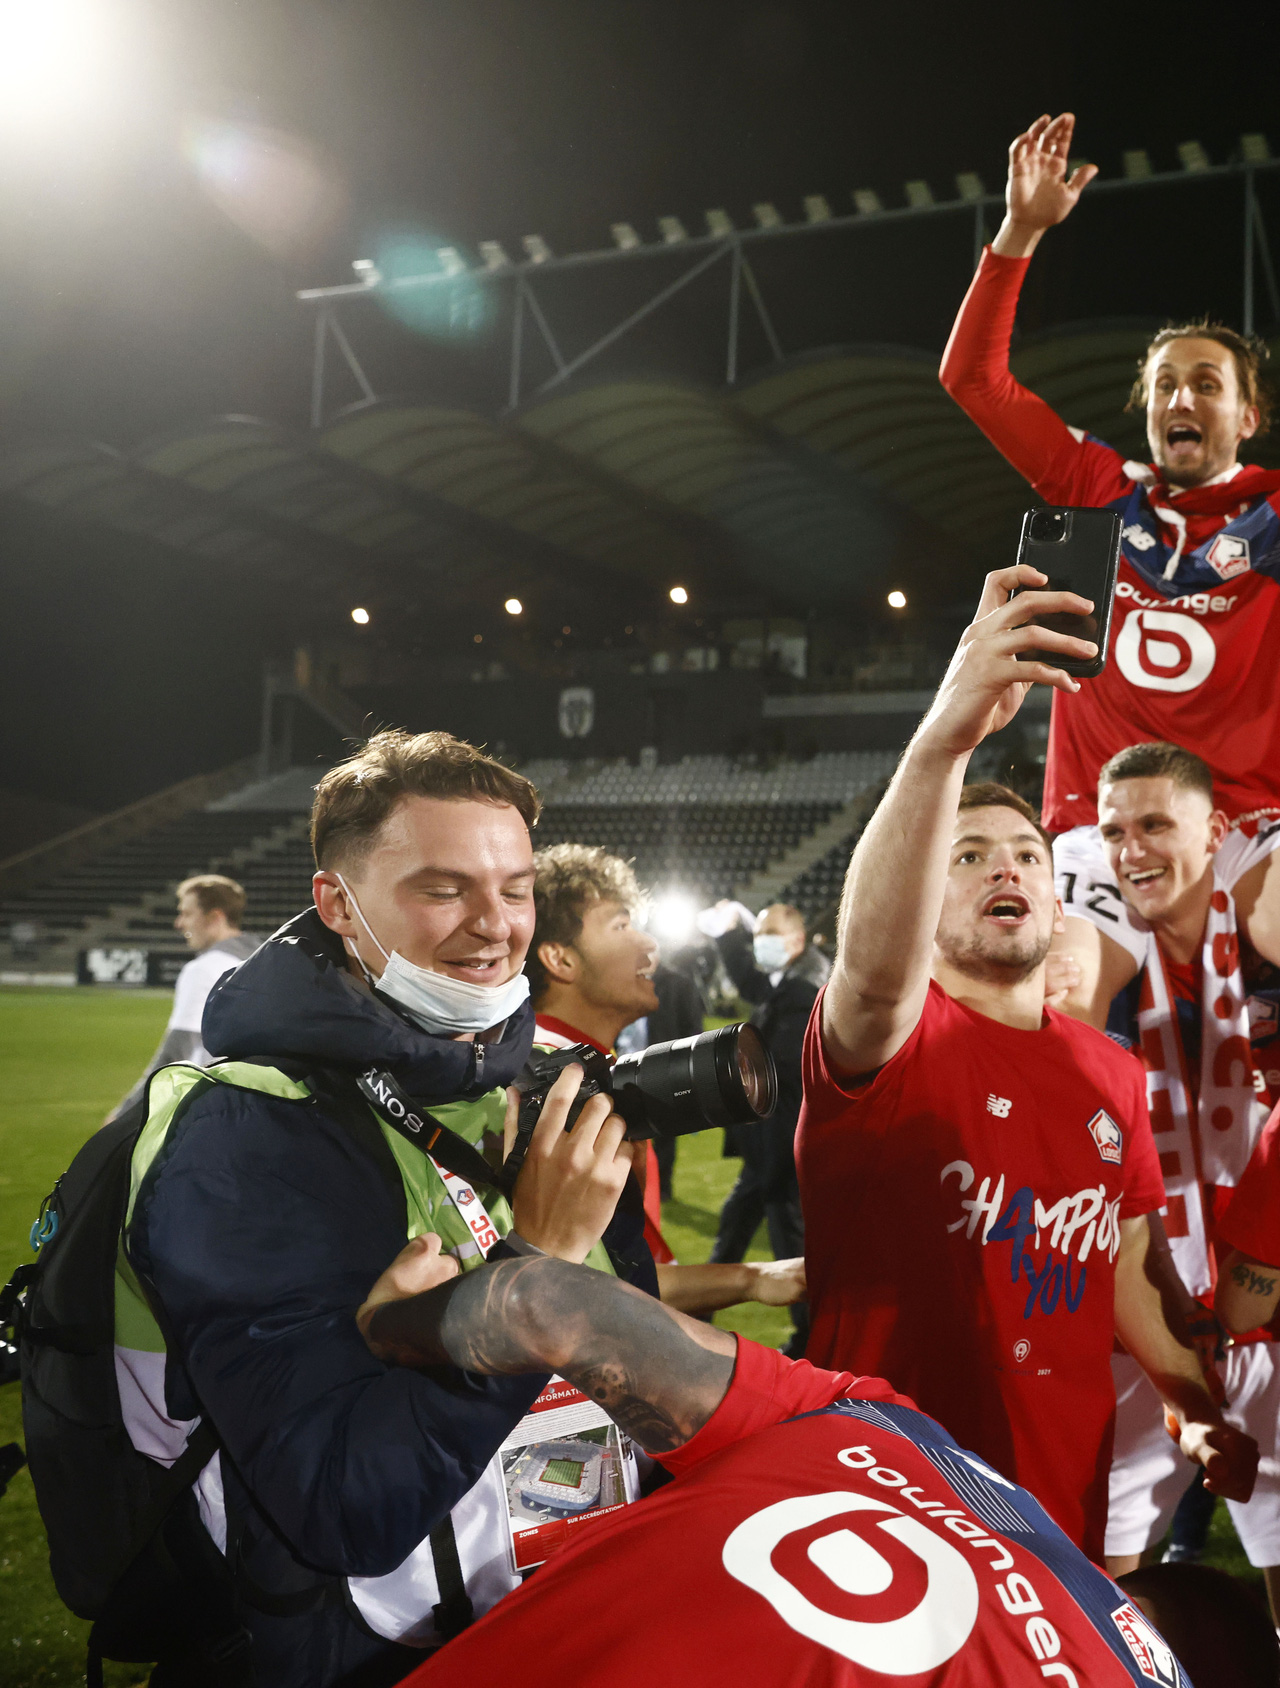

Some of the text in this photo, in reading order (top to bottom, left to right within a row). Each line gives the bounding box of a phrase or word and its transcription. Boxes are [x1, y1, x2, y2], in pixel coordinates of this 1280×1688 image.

[1060, 872, 1122, 923] 12
[363, 1066, 424, 1133] SONY
[673, 1088, 693, 1097] SONY
[519, 1528, 539, 1538] ZONES
[837, 1444, 1080, 1688] boulanger
[1117, 1620, 1152, 1670] LOSC
